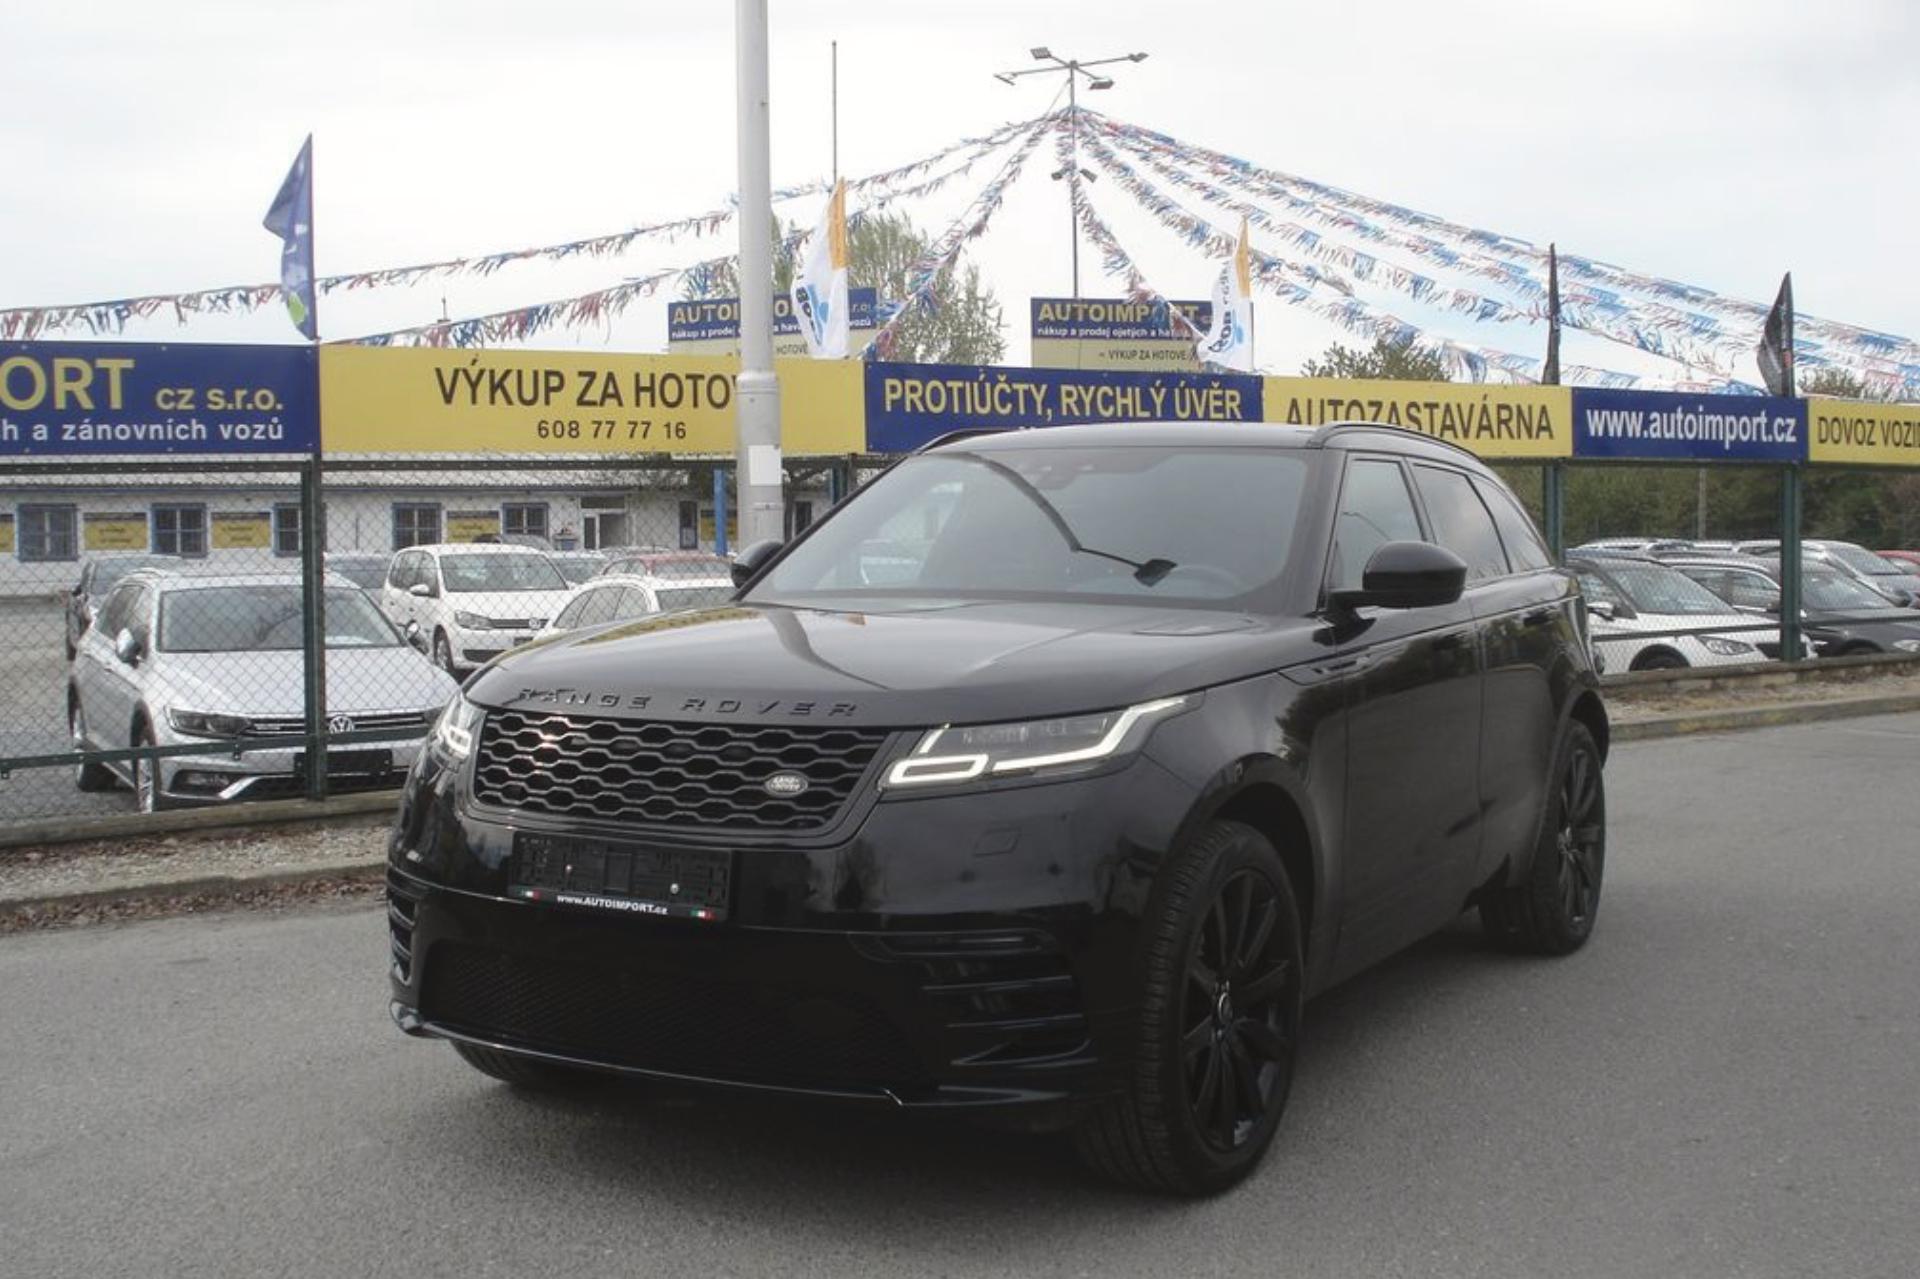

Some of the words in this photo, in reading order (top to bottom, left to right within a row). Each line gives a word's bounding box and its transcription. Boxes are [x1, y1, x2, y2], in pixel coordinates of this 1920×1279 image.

[435, 359, 565, 406] VÝKUP
[577, 370, 624, 408] ZA
[634, 372, 737, 410] HOTO
[884, 367, 1053, 421] PROTIÚČTY,
[1061, 378, 1167, 417] RYCHLÝ
[1174, 378, 1242, 420] ÚVĚR
[206, 387, 283, 411] s.r.o.
[32, 424, 48, 441] a
[61, 418, 207, 441] zánovních
[220, 416, 283, 441] vozů
[537, 420, 580, 439] 608
[591, 420, 616, 439] 77
[628, 420, 651, 439] 77
[663, 421, 687, 440] 16
[1586, 405, 1797, 450] www.autoimport.cz
[1817, 416, 1876, 446] DOVOZ
[679, 698, 857, 717] ROVER
